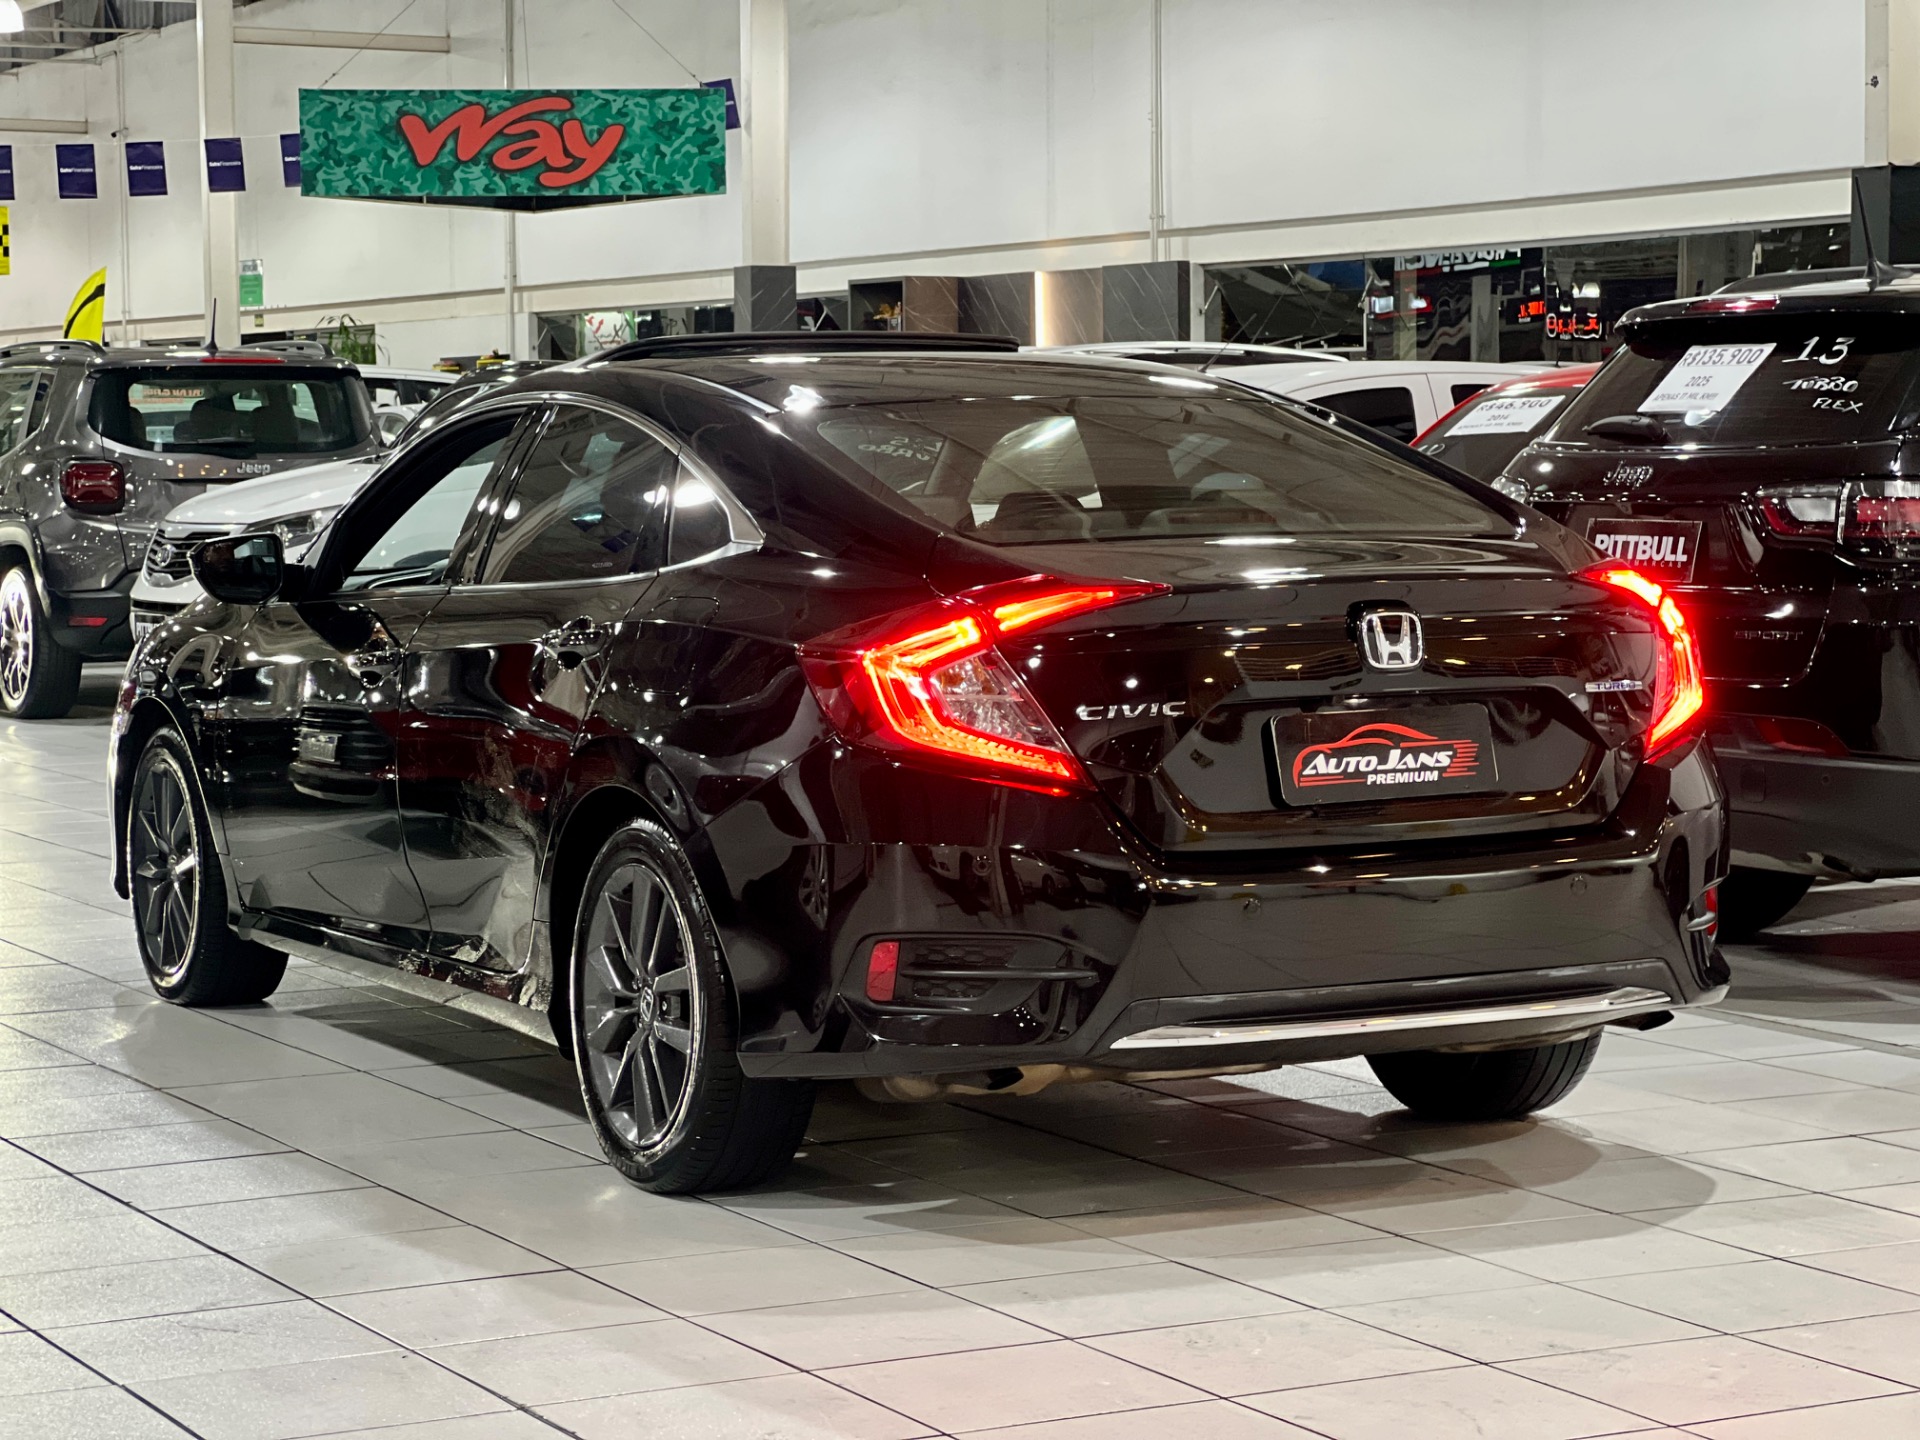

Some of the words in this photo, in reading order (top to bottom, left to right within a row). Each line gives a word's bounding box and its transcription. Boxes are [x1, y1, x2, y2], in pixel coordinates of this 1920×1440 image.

[399, 97, 624, 188] Way
[1678, 348, 1765, 367] R$135.900
[1782, 336, 1856, 365] 1.3
[1685, 376, 1713, 387] 2025
[1812, 398, 1863, 414] FLEX
[236, 462, 271, 476] Jeep
[1602, 460, 1653, 490] Jeep
[1594, 533, 1688, 562] PITTBULL
[1596, 681, 1636, 691] TURBO
[1076, 701, 1186, 720] CIVIC
[1366, 770, 1439, 785] PREMIUM
